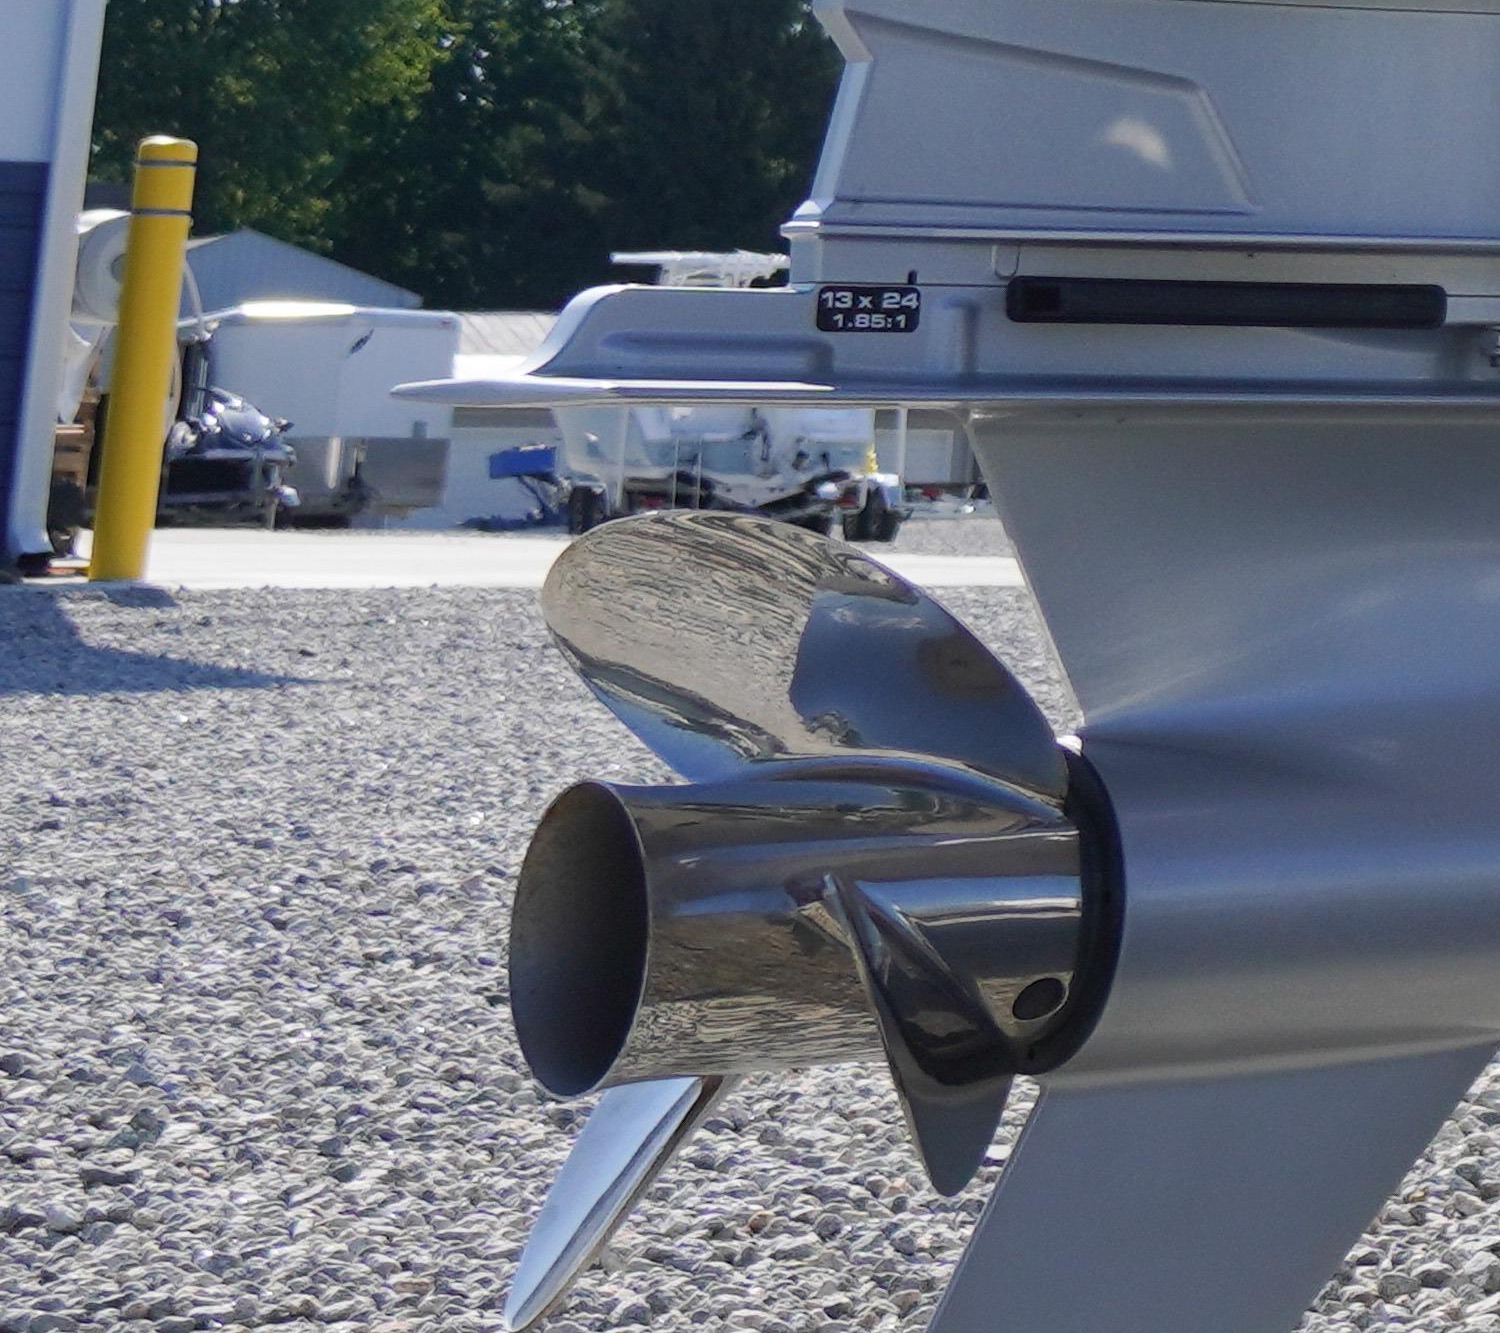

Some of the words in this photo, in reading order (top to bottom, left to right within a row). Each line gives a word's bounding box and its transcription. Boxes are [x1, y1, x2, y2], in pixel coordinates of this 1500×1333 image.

[820, 291, 852, 309] 13
[881, 291, 919, 310] 24
[832, 313, 907, 329] 1.85:1
